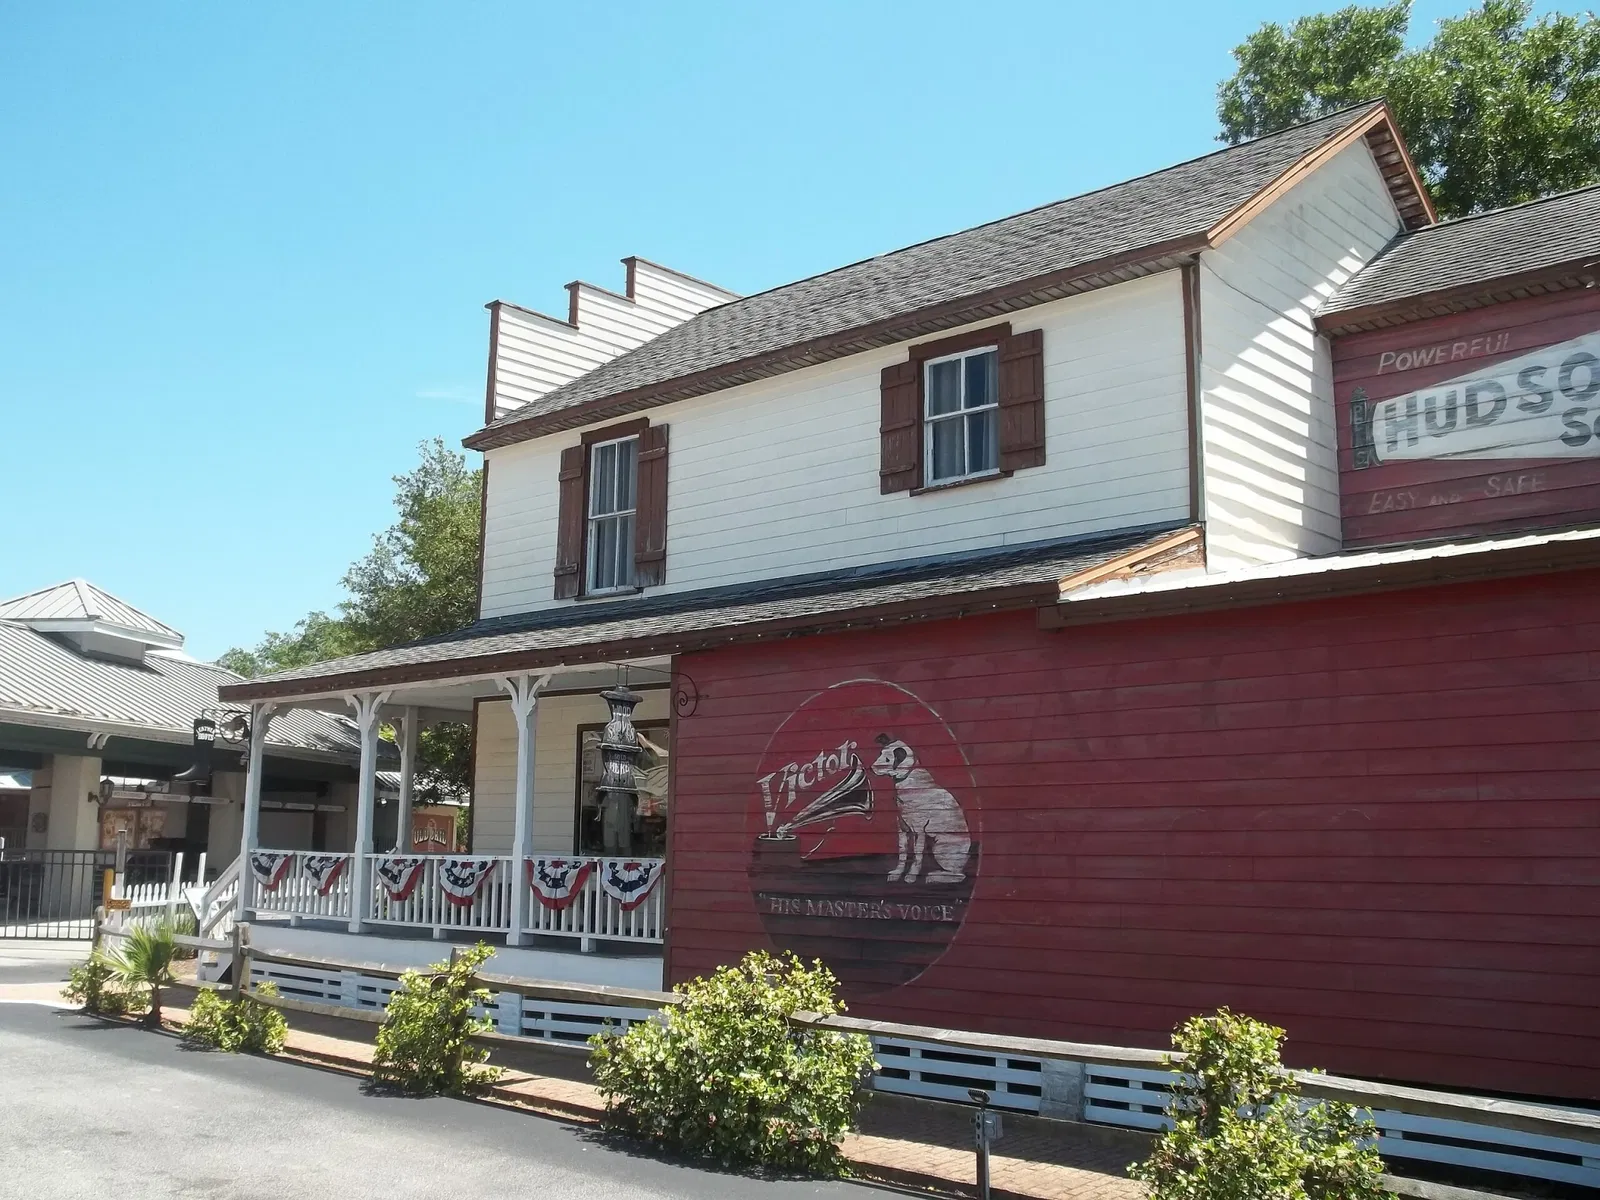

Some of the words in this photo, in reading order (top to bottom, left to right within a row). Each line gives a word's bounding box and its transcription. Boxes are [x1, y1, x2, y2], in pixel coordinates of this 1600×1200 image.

[1377, 332, 1511, 375] POWERFUL
[1559, 406, 1600, 448] S
[1367, 492, 1418, 515] EASY
[1484, 473, 1547, 498] SAFE
[756, 739, 858, 836] Victor
